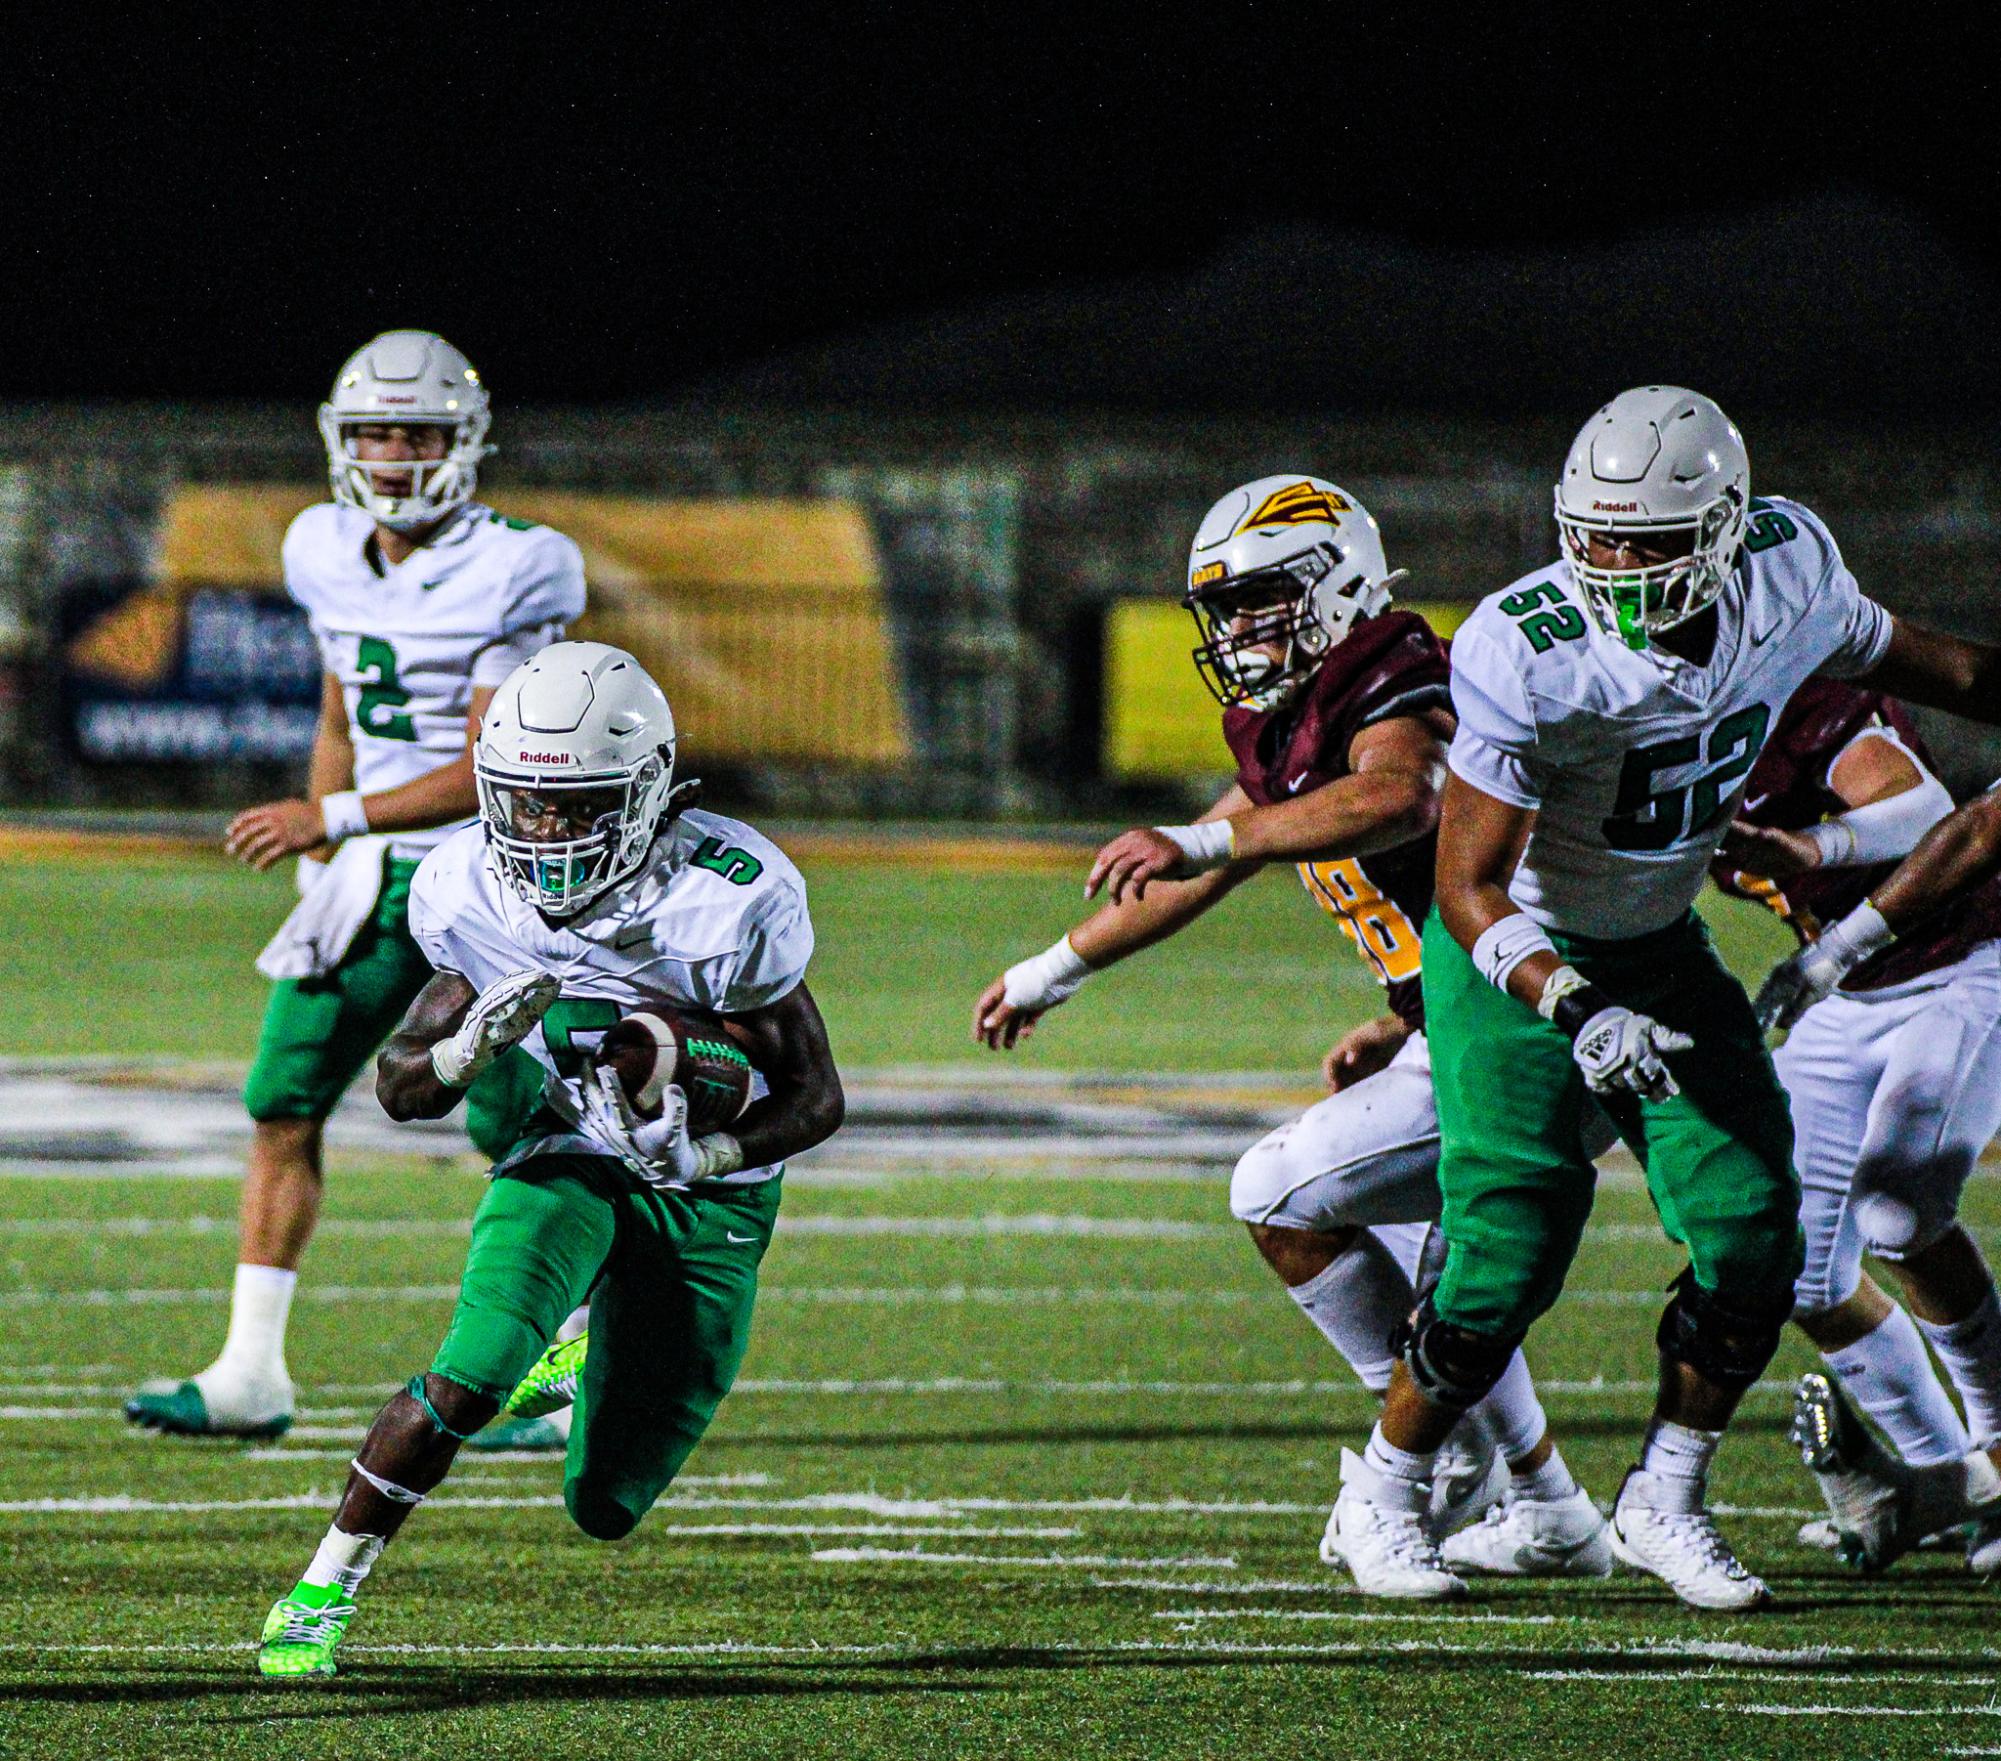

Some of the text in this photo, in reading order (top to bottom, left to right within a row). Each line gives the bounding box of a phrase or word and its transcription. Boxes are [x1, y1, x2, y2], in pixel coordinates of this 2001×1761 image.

[1593, 500, 1638, 513] Riddell
[1498, 580, 1587, 655] 52
[356, 634, 417, 742] 2
[519, 751, 570, 764] Riddell
[1602, 702, 1771, 851] 52
[688, 836, 764, 886] 5
